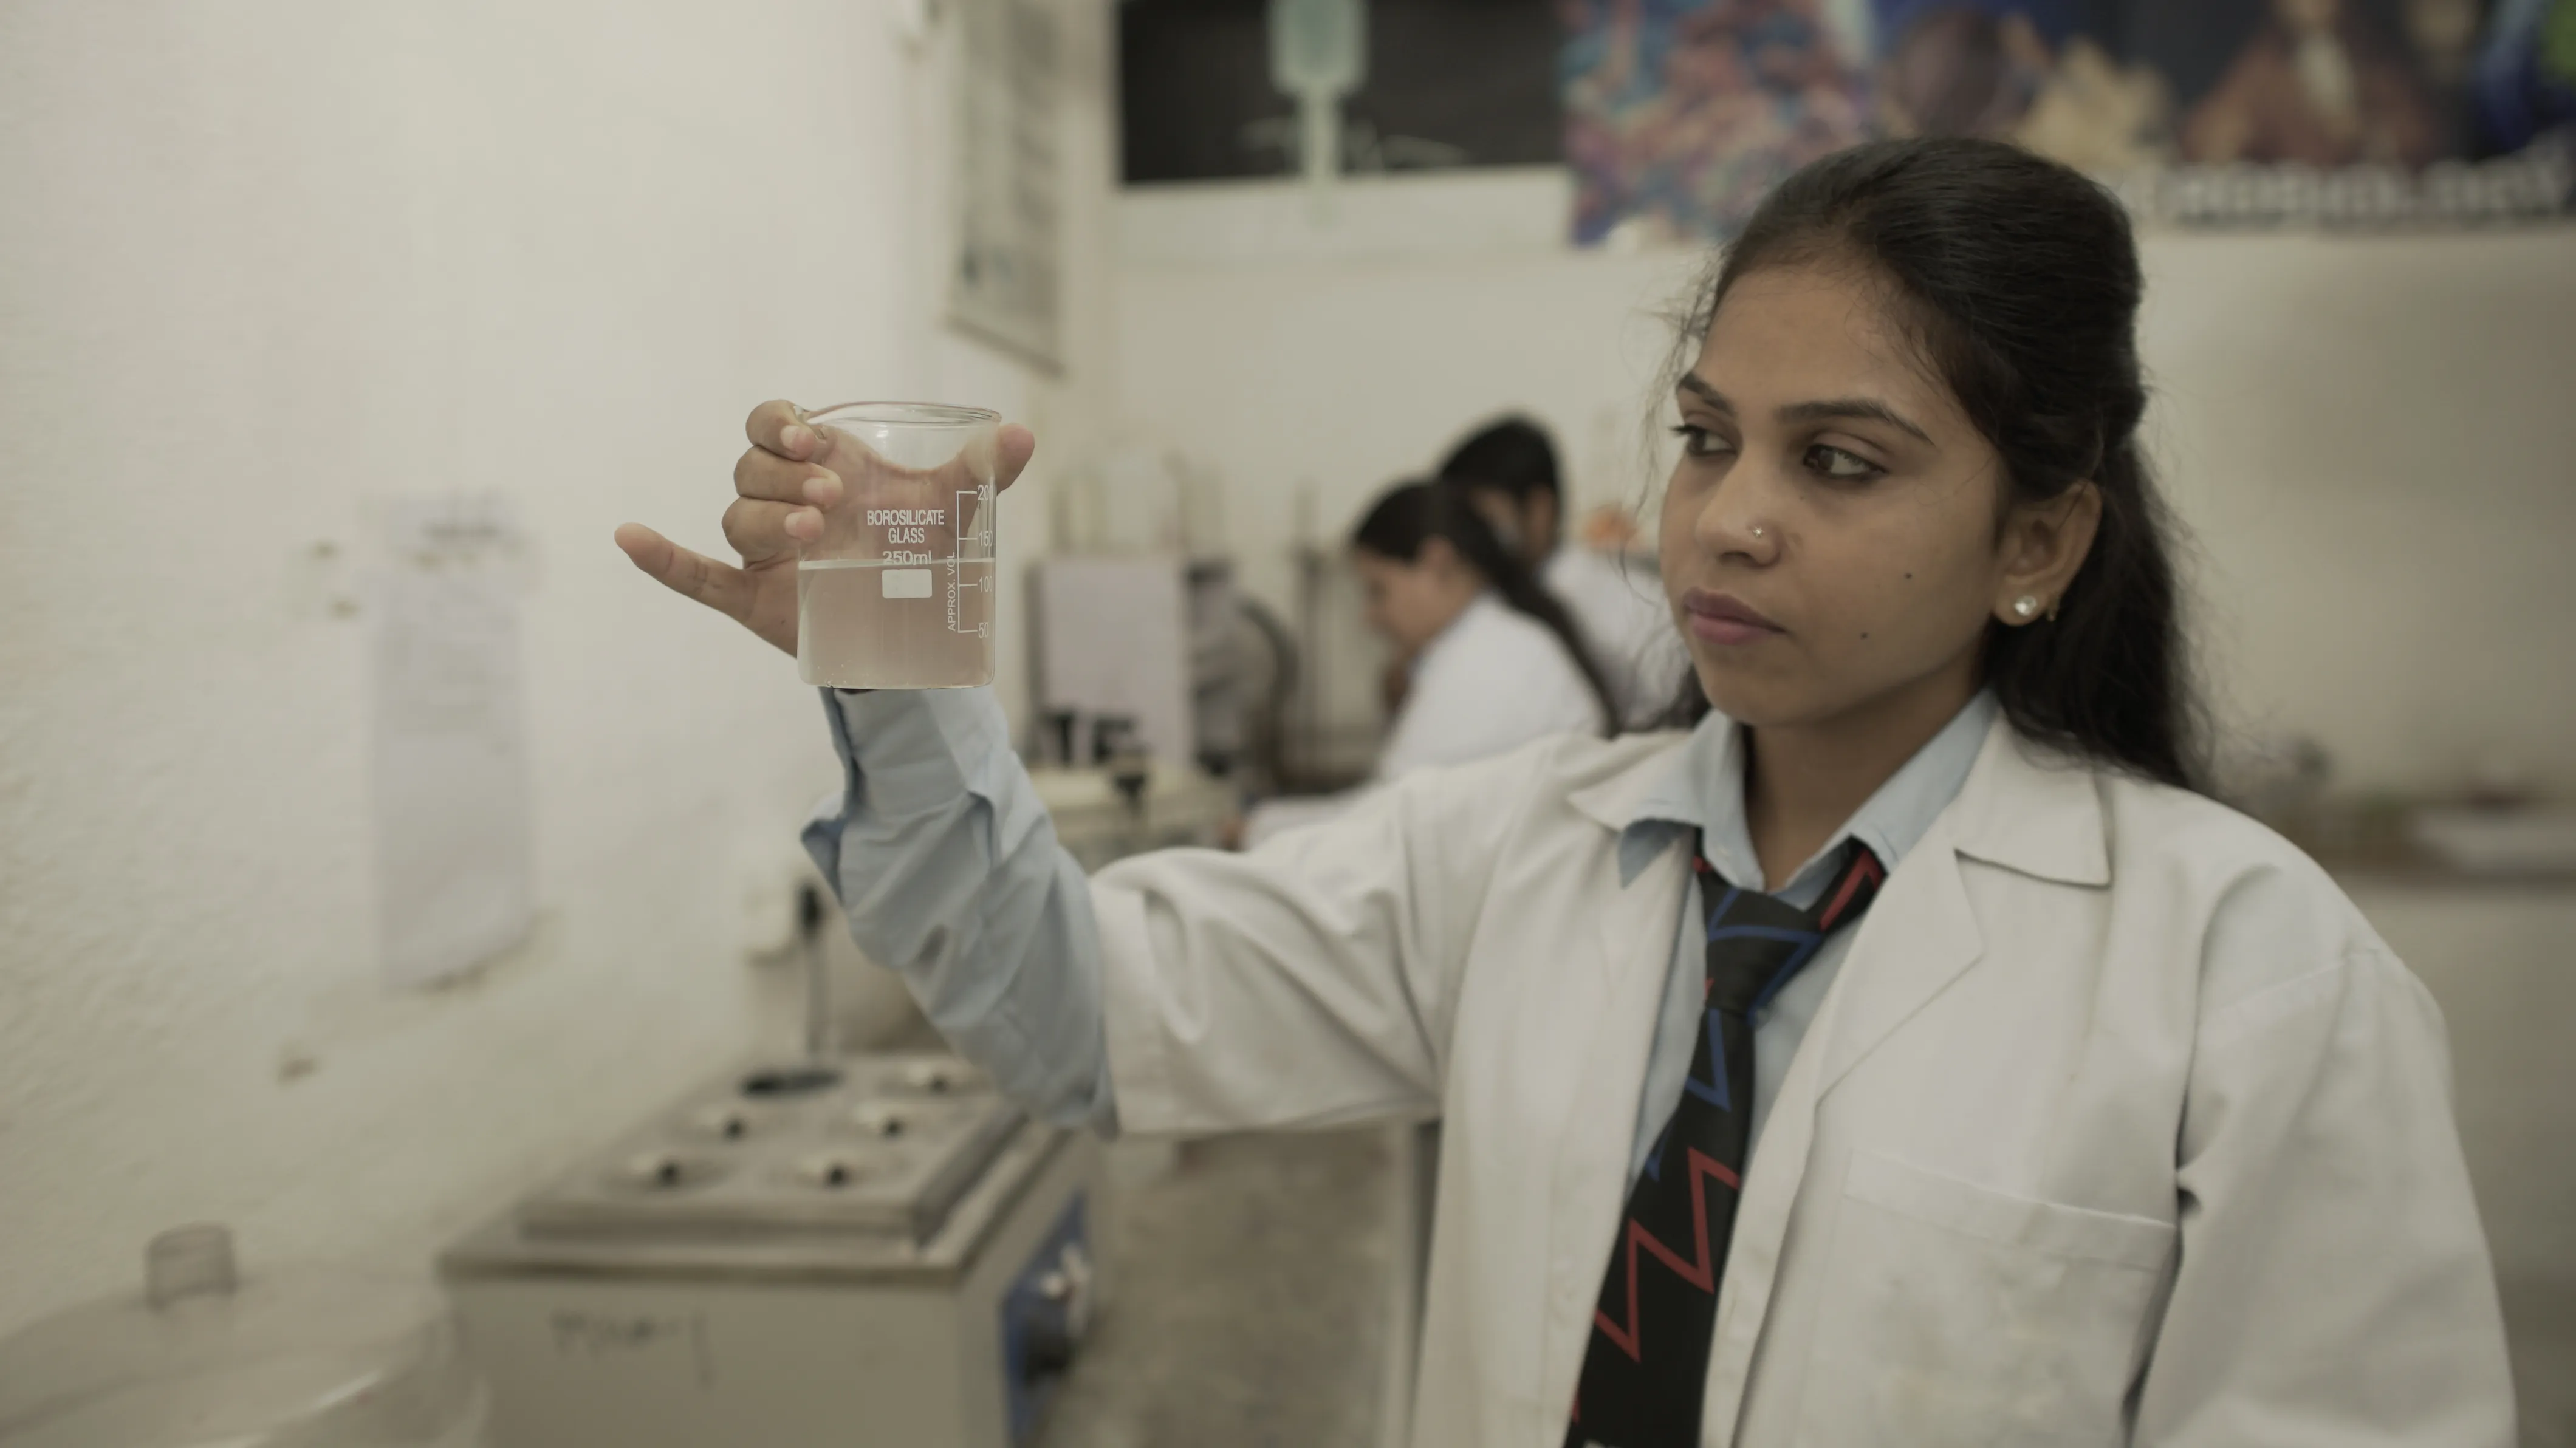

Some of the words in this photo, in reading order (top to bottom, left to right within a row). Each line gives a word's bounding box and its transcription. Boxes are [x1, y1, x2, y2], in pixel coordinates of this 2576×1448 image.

[867, 510, 945, 526] BOROSILICATE
[888, 527, 925, 544] GLASS
[979, 531, 993, 547] 150
[883, 550, 932, 565] 250ml
[979, 576, 993, 592] 100
[947, 578, 956, 632] APPROX.
[978, 622, 989, 638] 50
